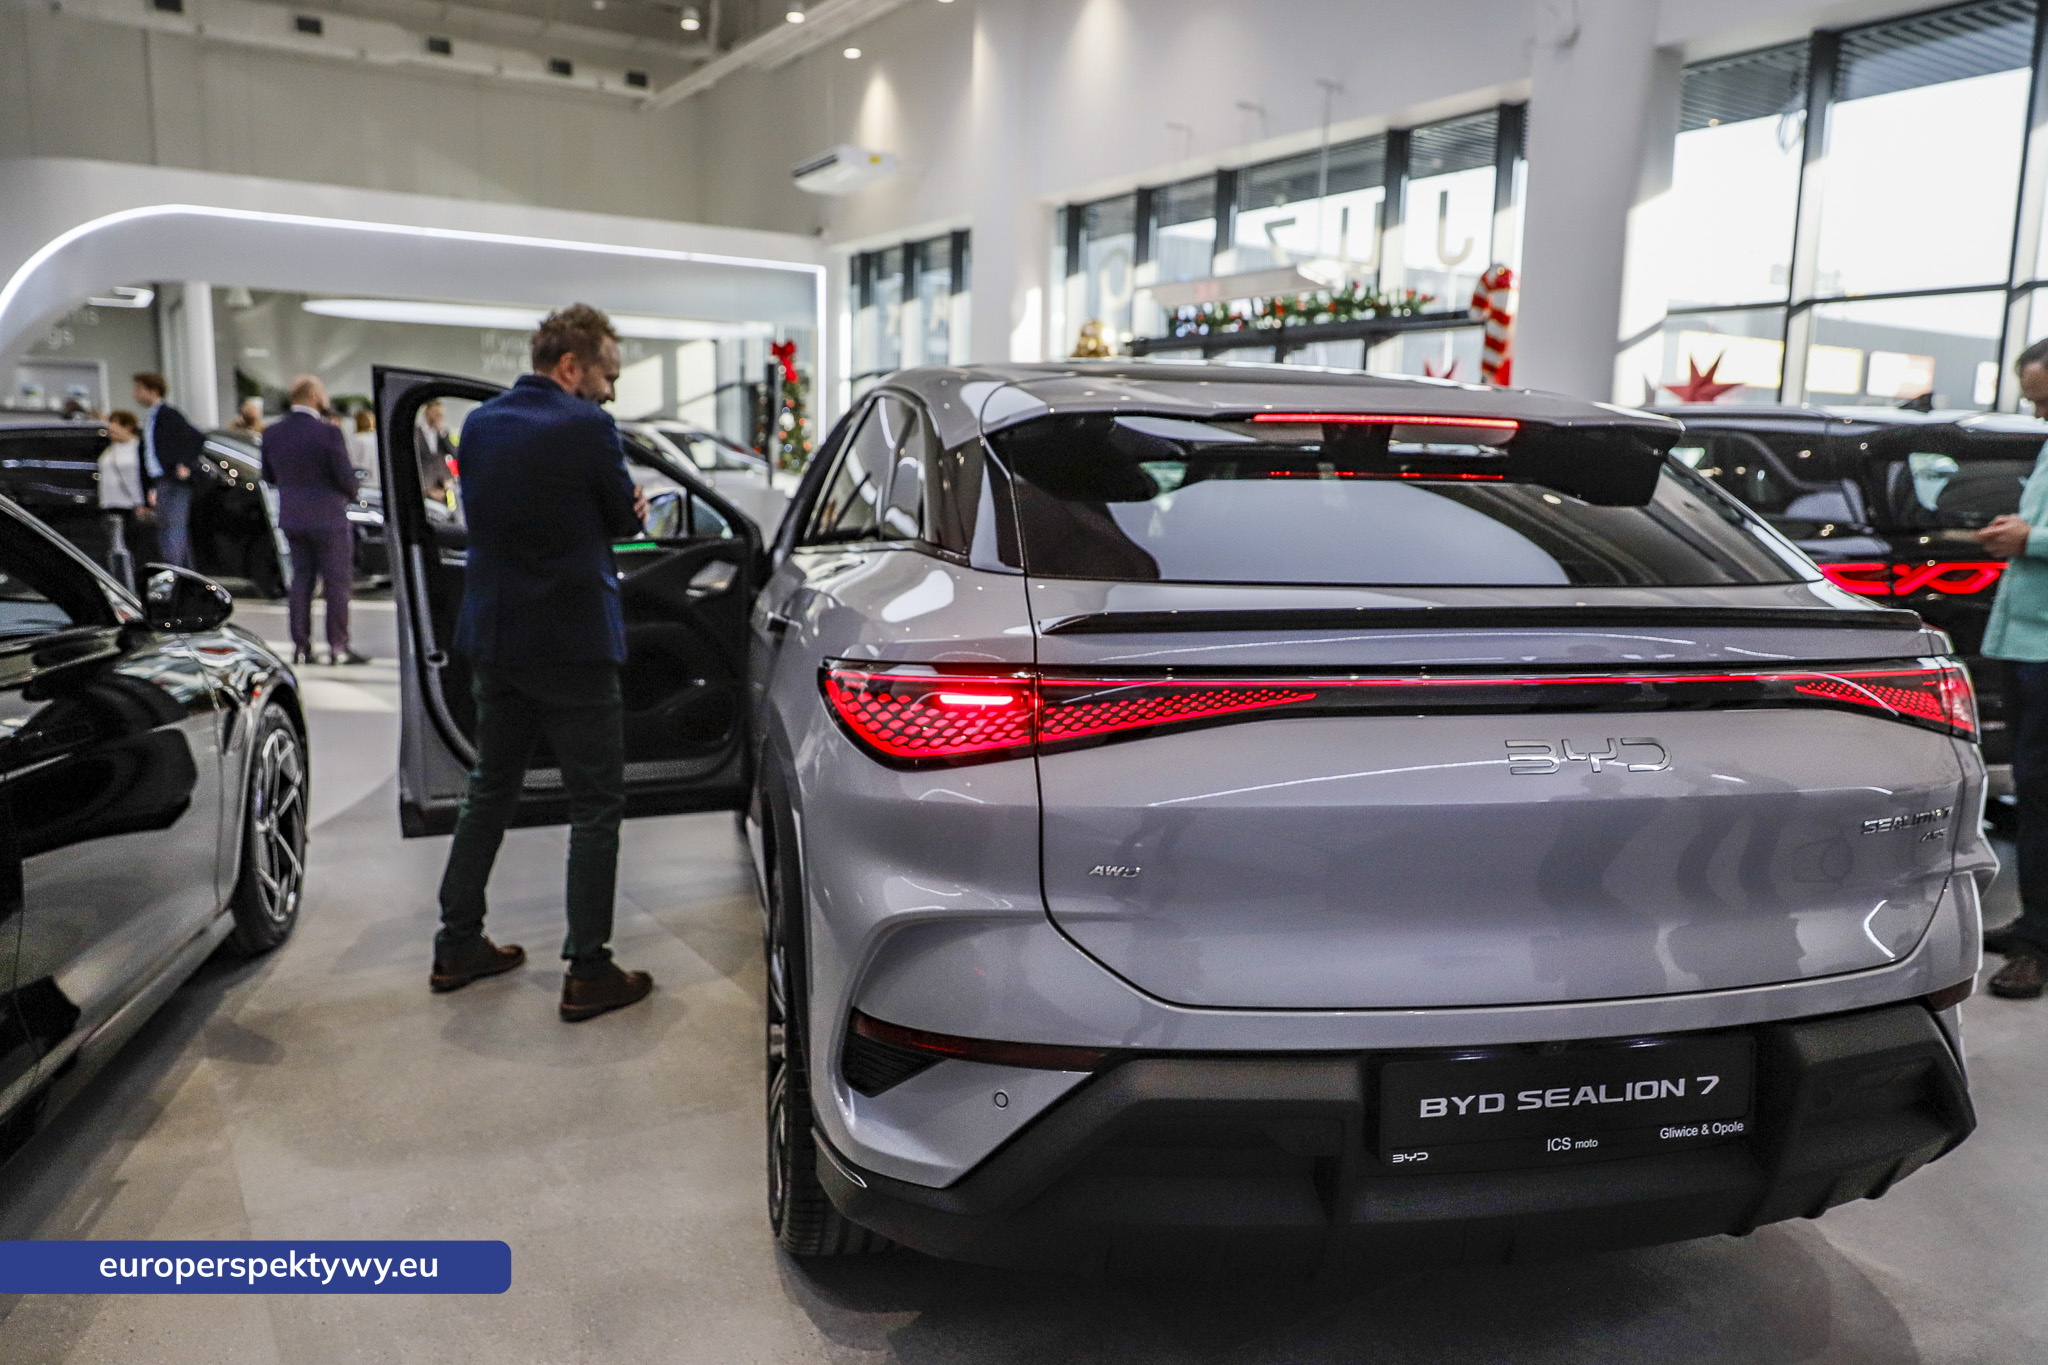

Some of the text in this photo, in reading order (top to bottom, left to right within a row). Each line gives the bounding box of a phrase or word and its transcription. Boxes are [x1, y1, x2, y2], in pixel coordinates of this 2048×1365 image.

[1505, 737, 1673, 776] BYD
[1087, 864, 1141, 878] AWD
[1420, 1074, 1720, 1119] BYD SEALION 7
[1659, 1120, 1745, 1140] Gliwice & Opole
[1546, 1136, 1599, 1152] ICS moto
[1392, 1151, 1429, 1164] BYD
